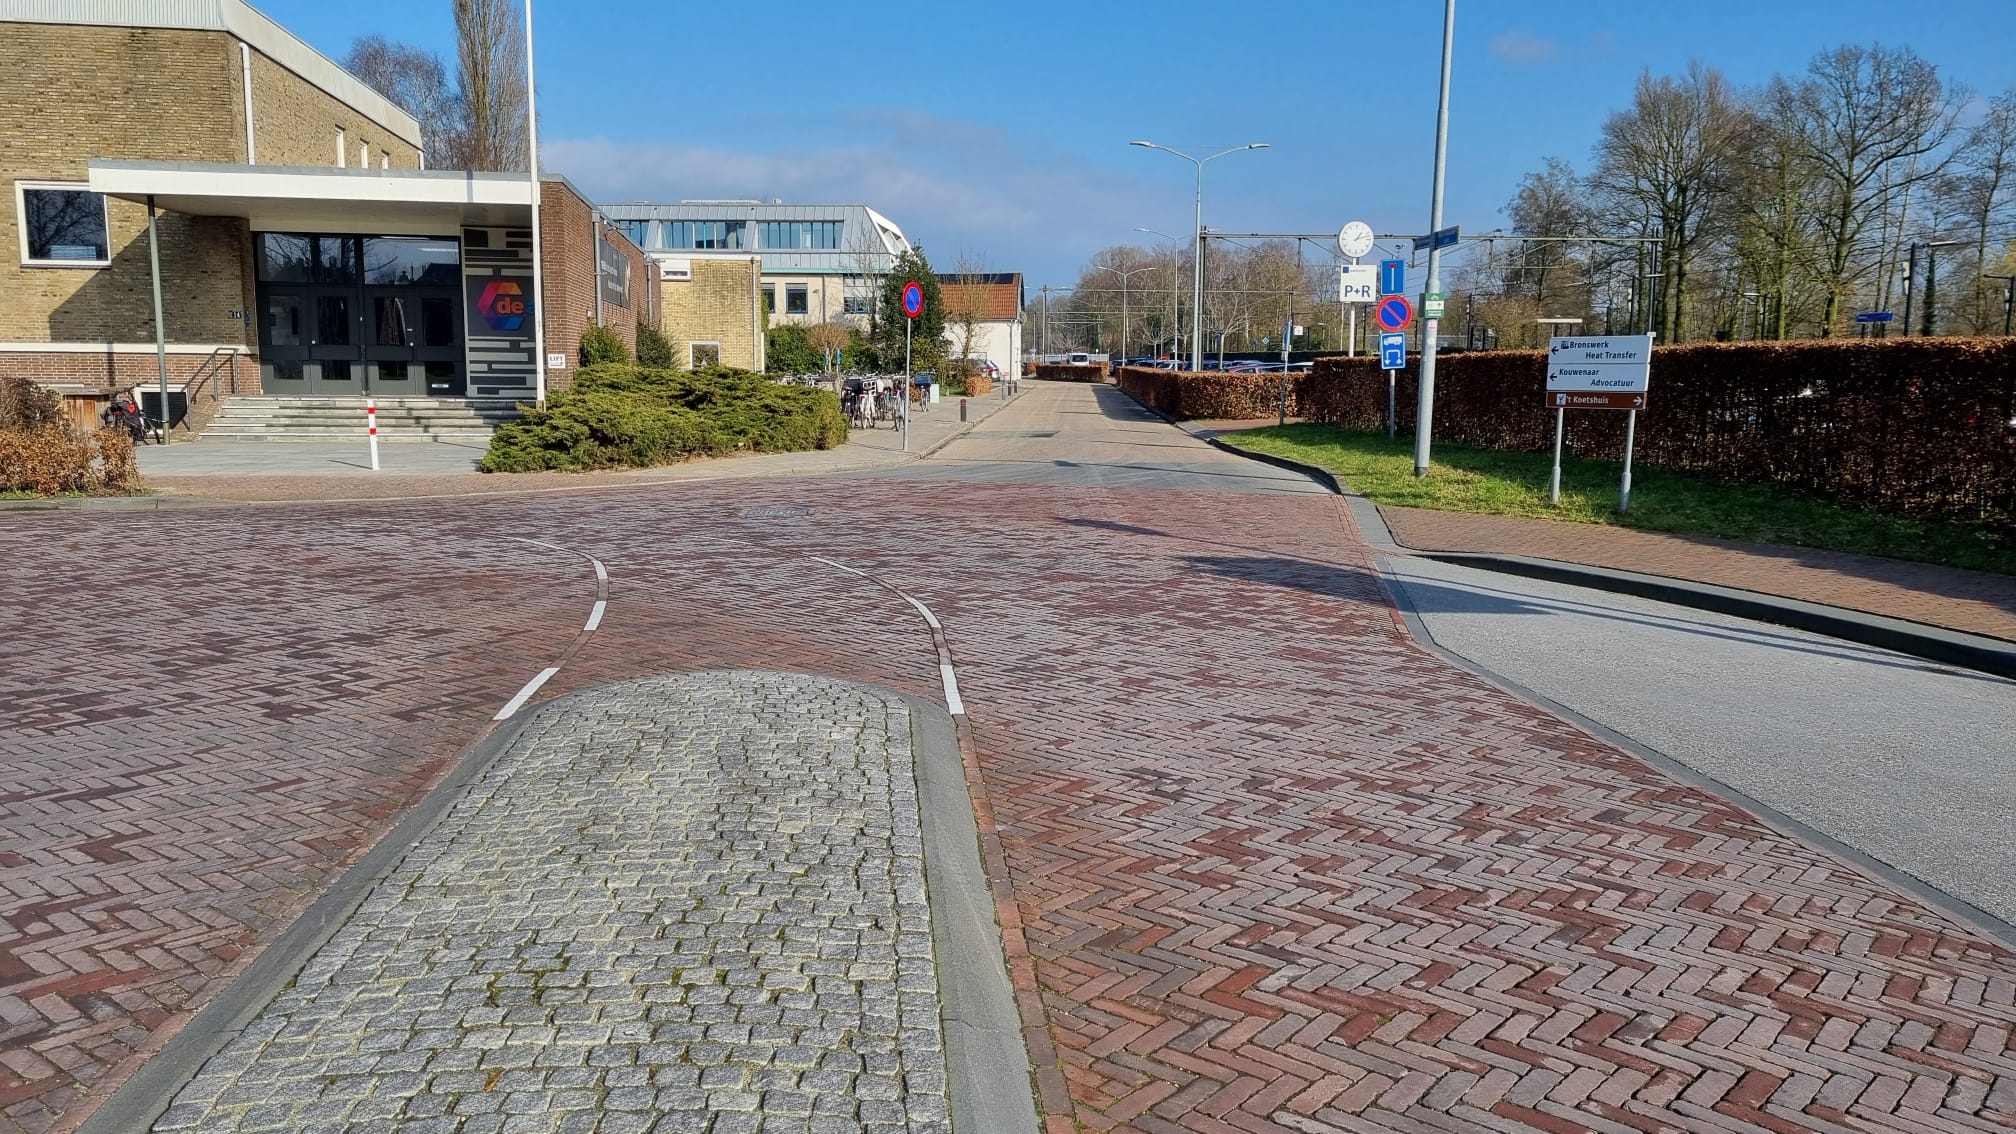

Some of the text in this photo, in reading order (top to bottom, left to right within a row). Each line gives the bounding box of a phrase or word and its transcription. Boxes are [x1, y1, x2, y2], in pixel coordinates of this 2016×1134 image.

[1344, 285, 1371, 298] P+R
[1569, 341, 1609, 349] Bronswerk
[1585, 351, 1637, 359] Heat Transfer
[1590, 379, 1634, 387] Advocatuur
[1573, 396, 1609, 404] Koetshuis
